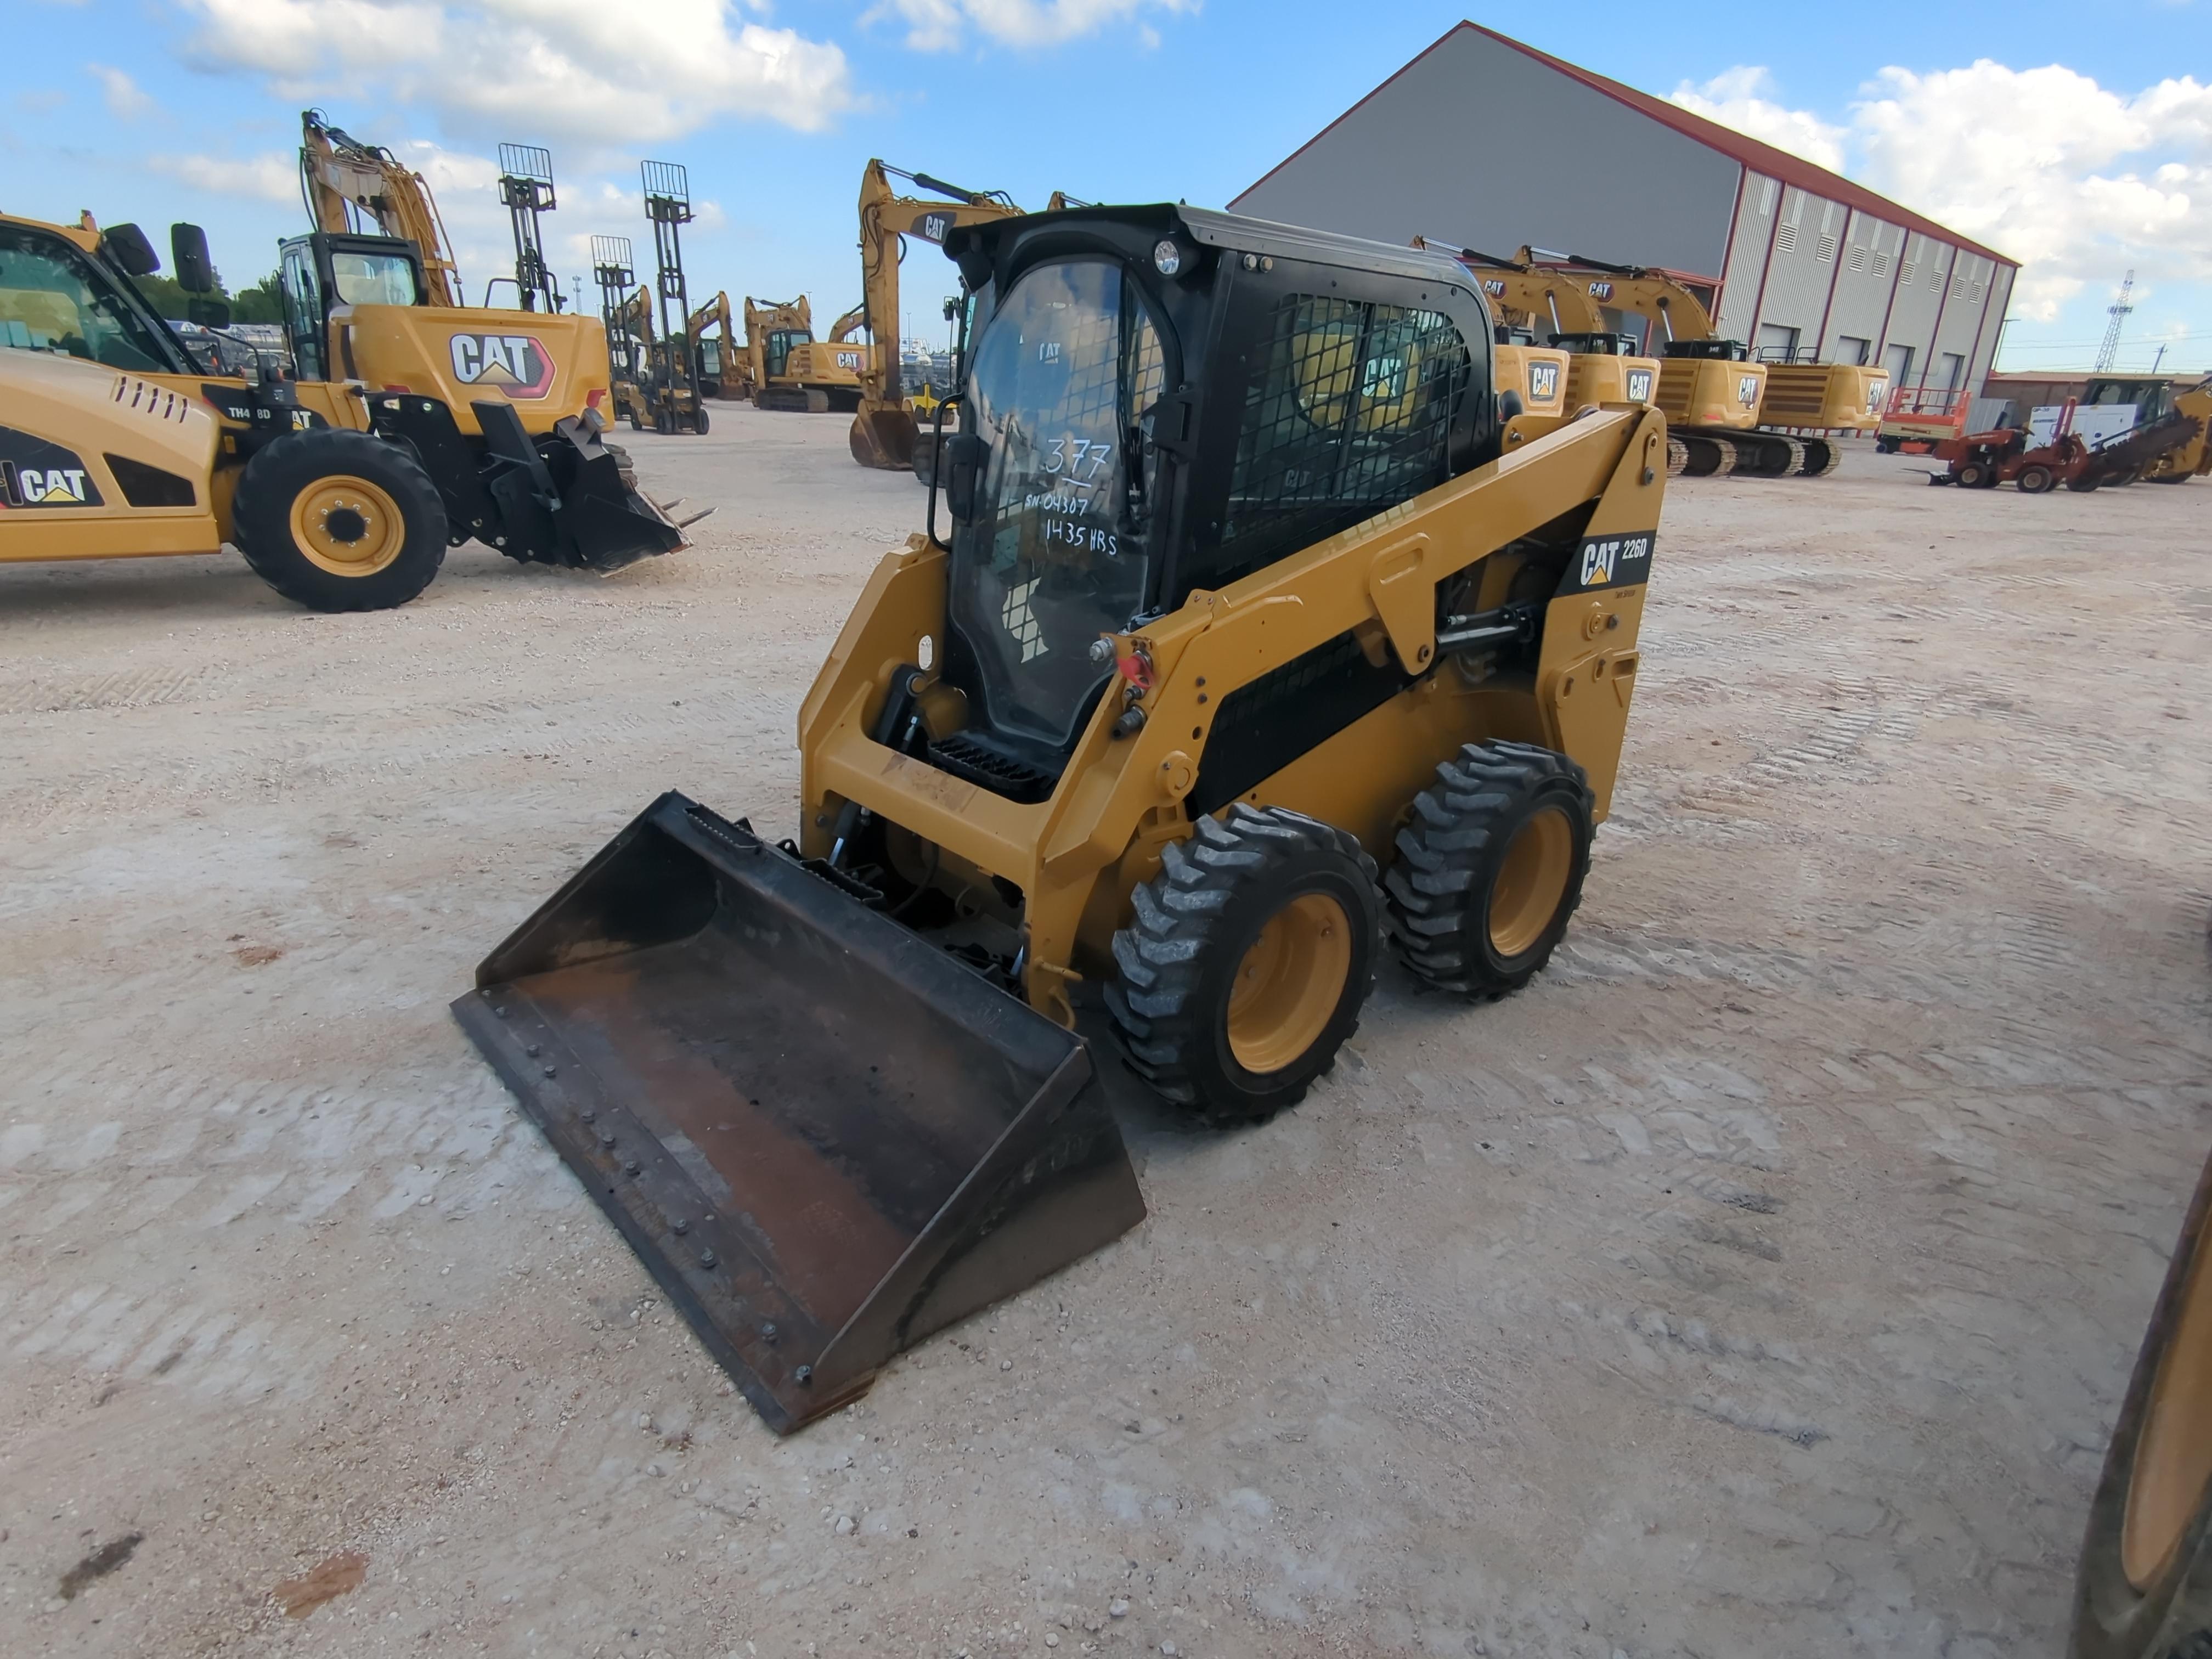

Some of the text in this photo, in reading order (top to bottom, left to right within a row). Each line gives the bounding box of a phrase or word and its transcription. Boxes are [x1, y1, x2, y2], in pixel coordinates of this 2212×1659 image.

[926, 215, 945, 241] CAT
[1485, 280, 1503, 295] CAT
[1588, 283, 1611, 298] CAT
[451, 335, 529, 383] CAT
[837, 353, 857, 368] CAT
[1362, 358, 1401, 397] CAT
[1533, 367, 1556, 396] CAT
[1629, 374, 1649, 400] CAT
[1738, 377, 1756, 402] CAT
[228, 407, 311, 428] TH48D AT
[1046, 439, 1111, 479] 377
[21, 470, 86, 502] CAT
[1046, 518, 1117, 555] 1435 HRS
[1581, 538, 1647, 585] CAT 226D
